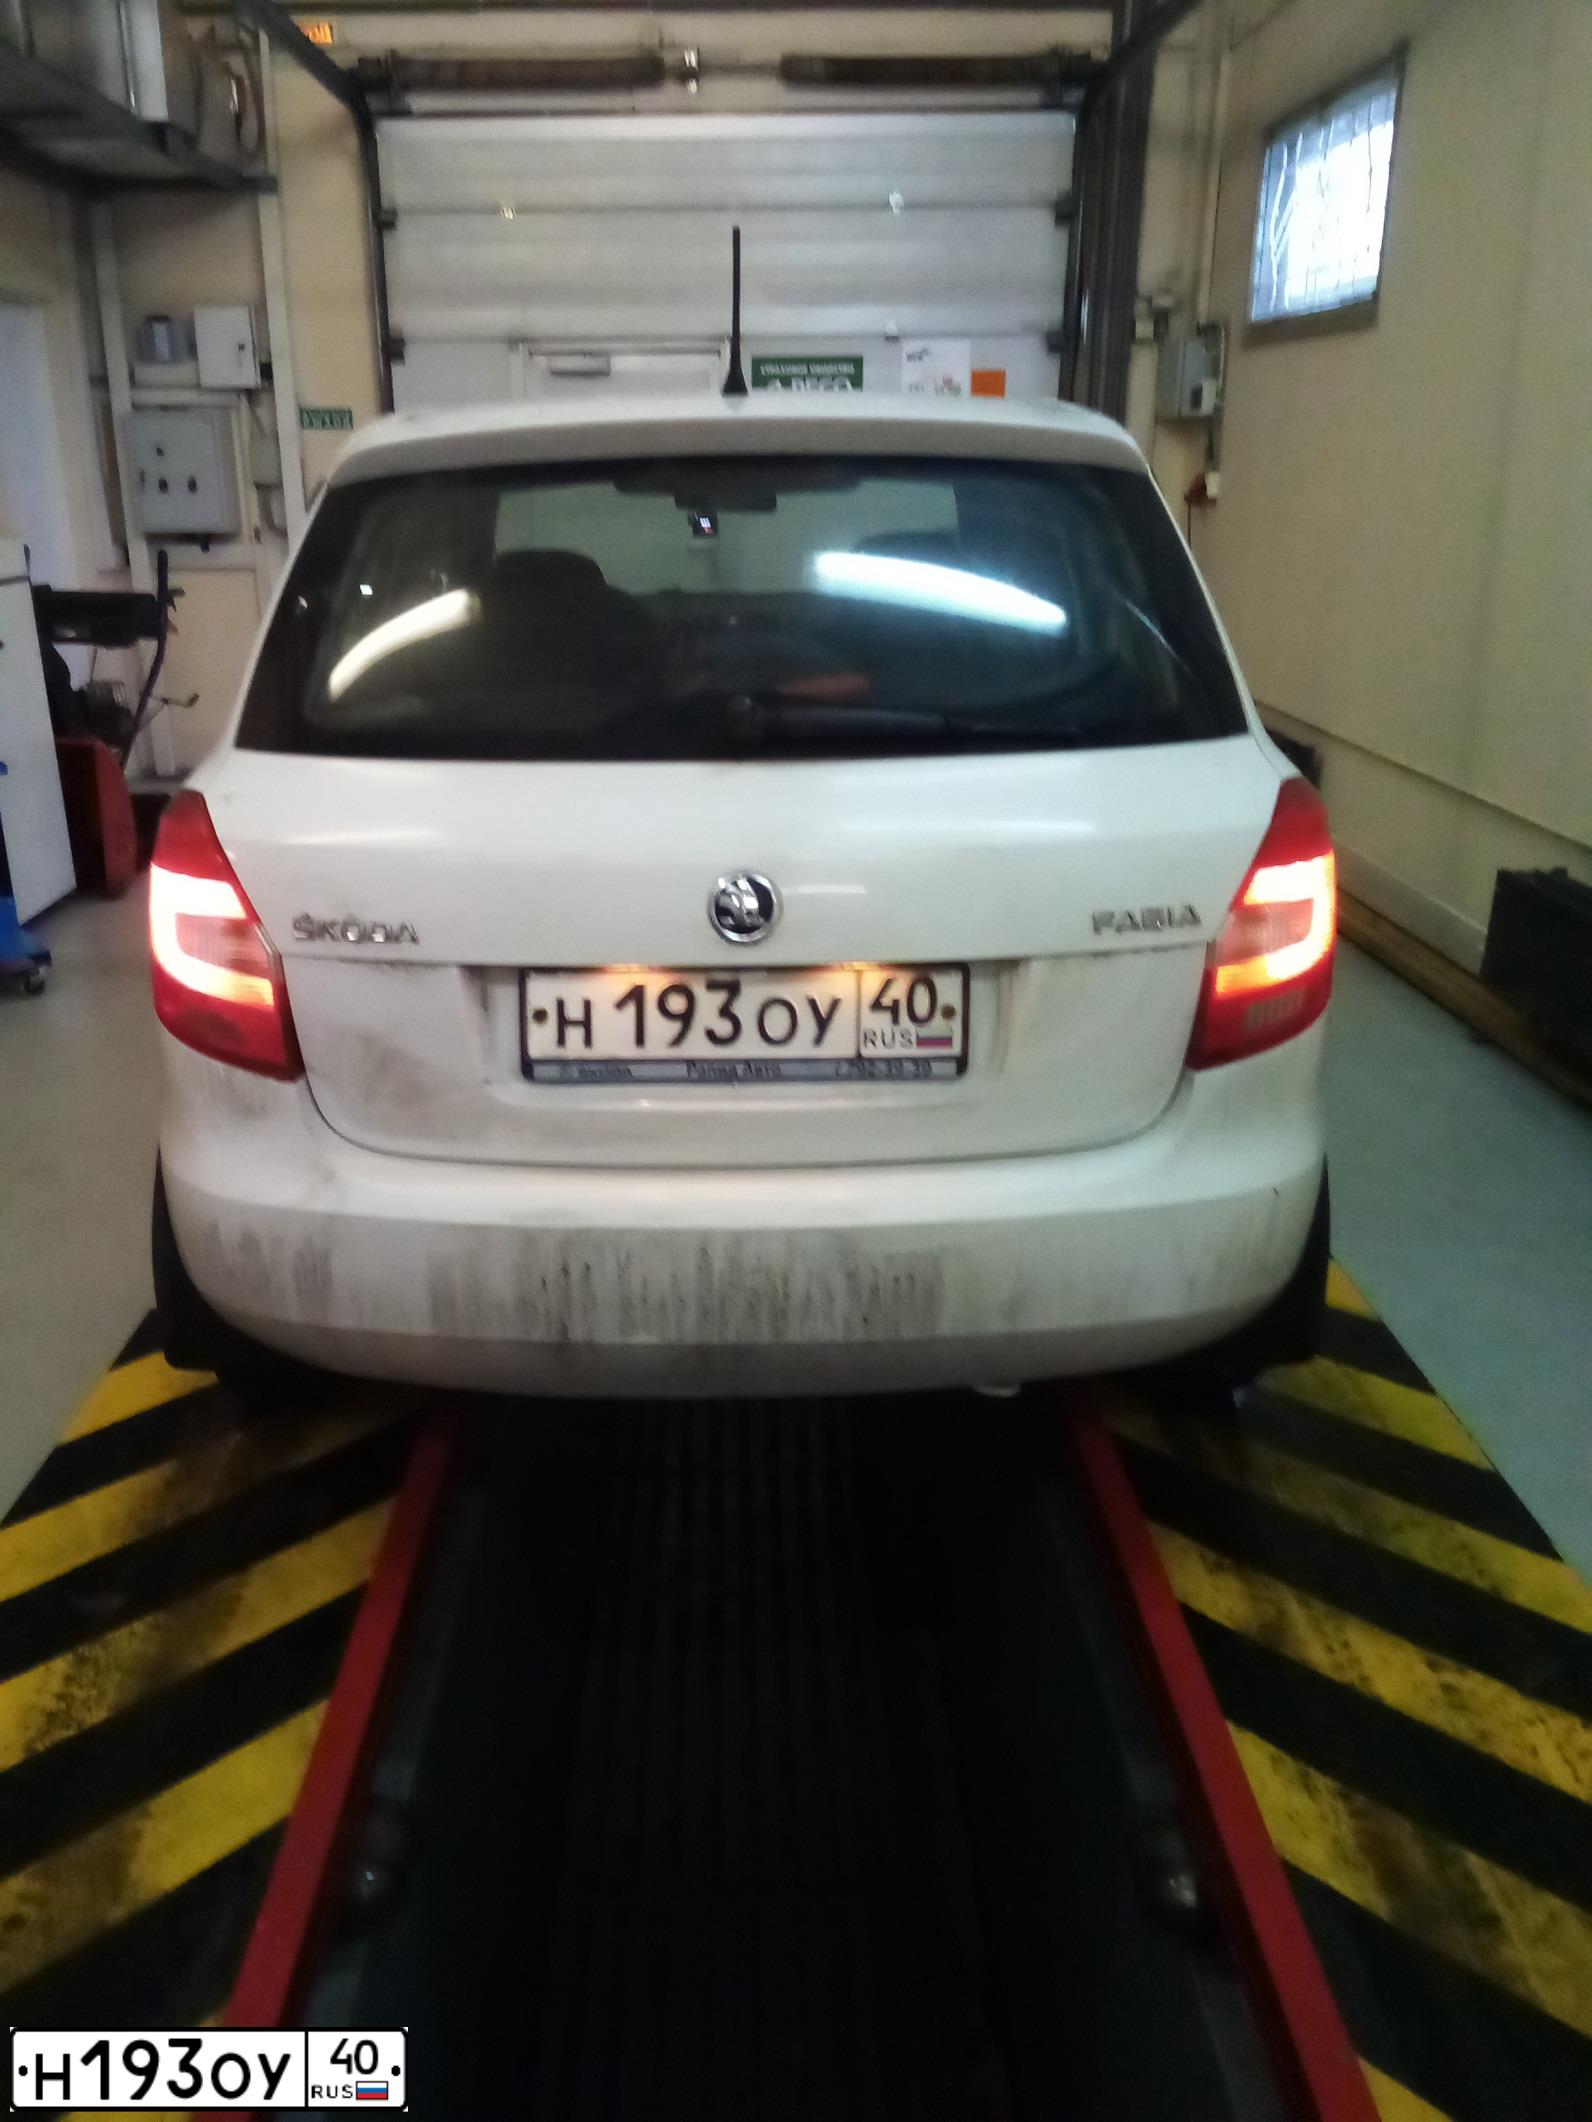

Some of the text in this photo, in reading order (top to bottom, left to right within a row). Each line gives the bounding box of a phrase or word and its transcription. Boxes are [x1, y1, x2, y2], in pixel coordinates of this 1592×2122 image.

[1092, 904, 1202, 934] FABIA
[556, 976, 937, 1048] Н193ОУ 40
[862, 1027, 914, 1049] RUS
